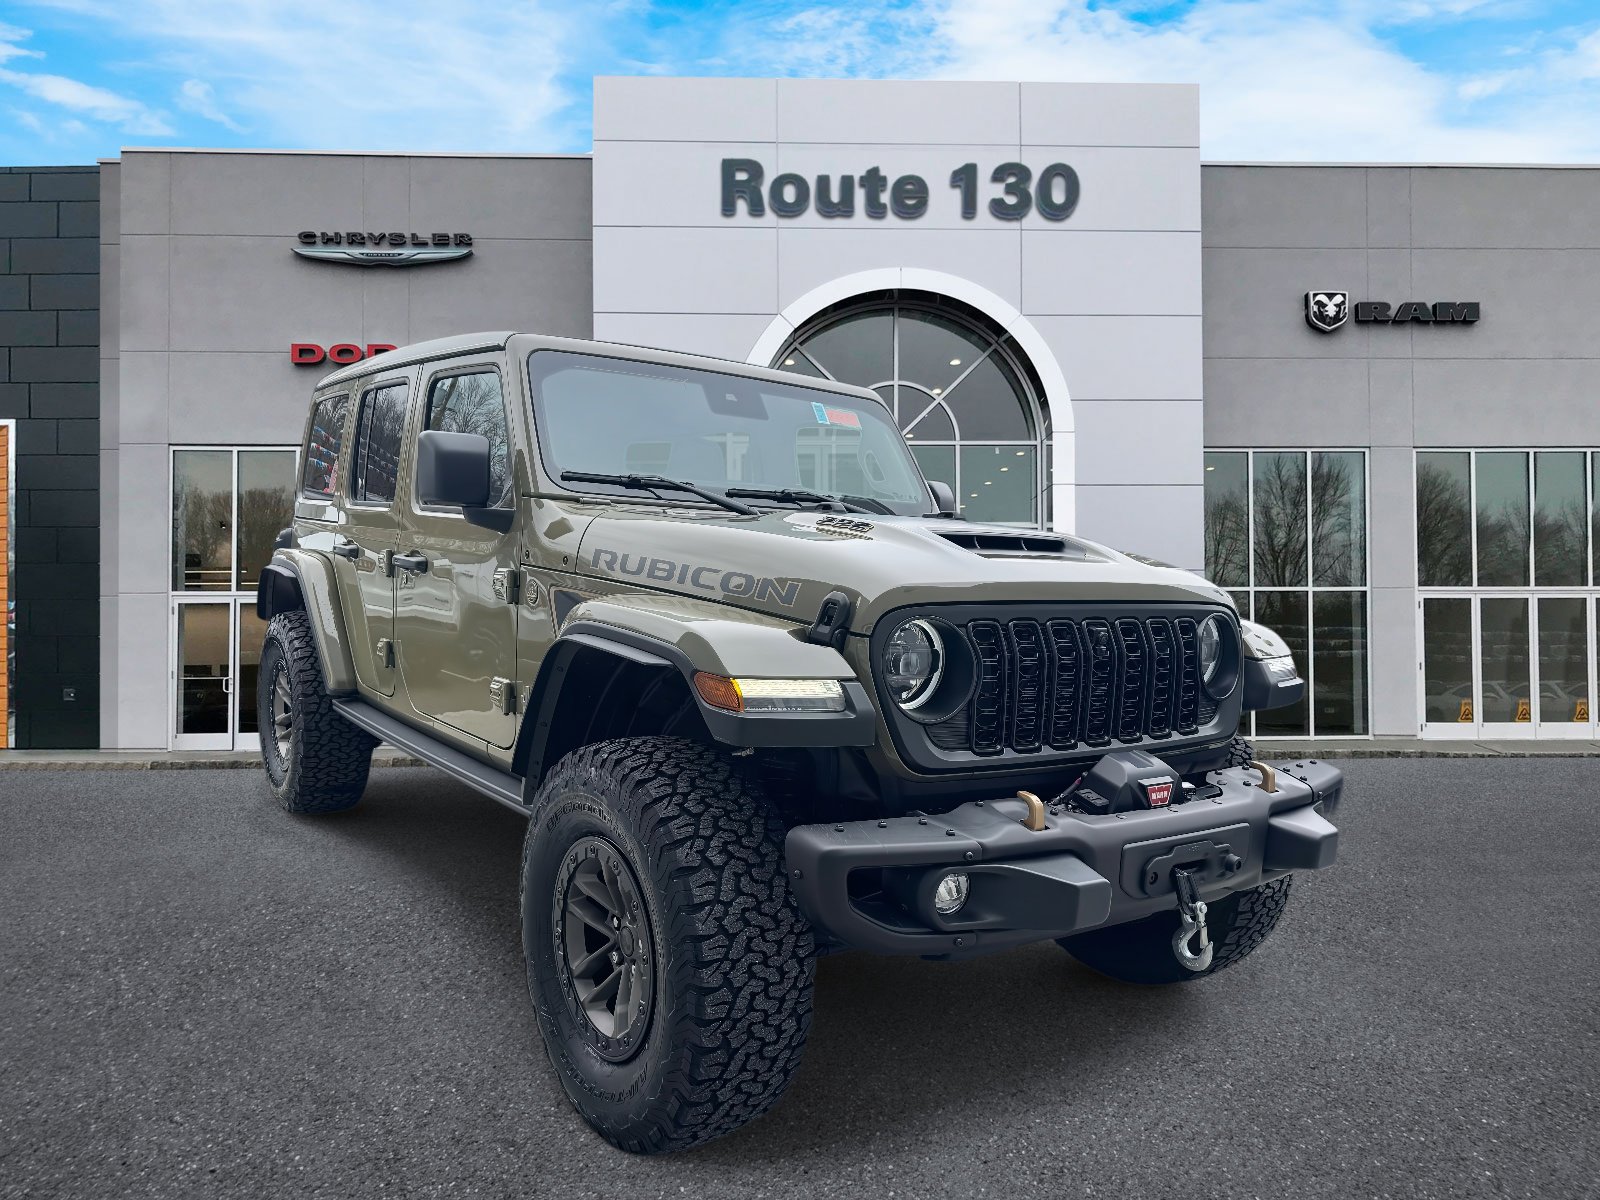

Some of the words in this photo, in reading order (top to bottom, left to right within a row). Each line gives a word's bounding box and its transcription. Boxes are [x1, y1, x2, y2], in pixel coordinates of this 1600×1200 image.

[721, 158, 929, 218] Route
[950, 162, 1080, 221] 130
[298, 231, 473, 246] CHRYSLER
[1355, 302, 1480, 323] RAM
[590, 548, 802, 608] RUBICON
